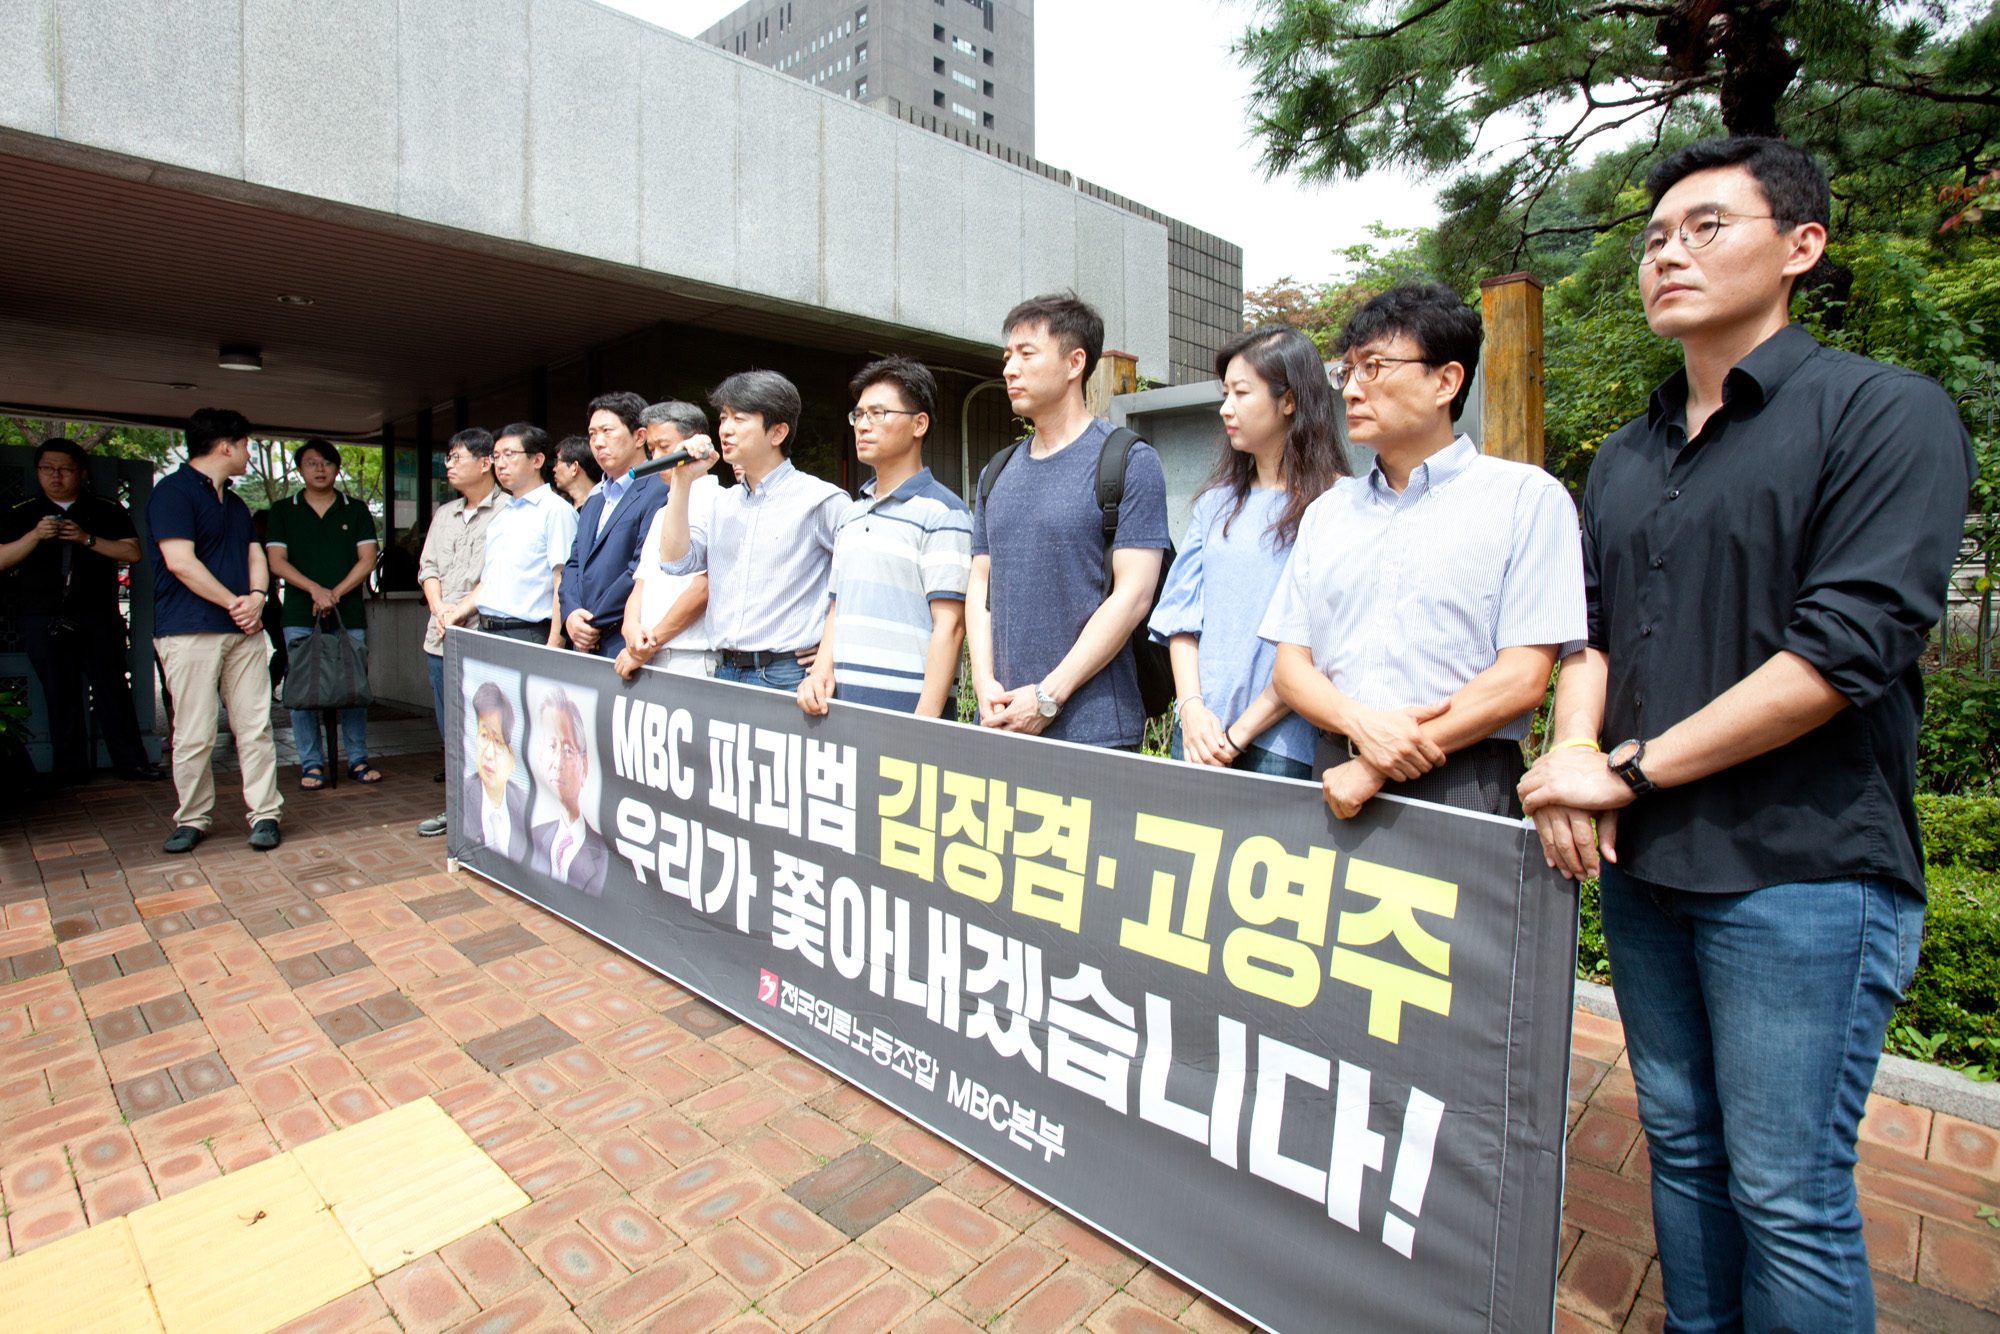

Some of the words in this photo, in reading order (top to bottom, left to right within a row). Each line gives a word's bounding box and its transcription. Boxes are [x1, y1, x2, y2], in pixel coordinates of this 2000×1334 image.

[612, 696, 694, 800] MBC
[709, 720, 857, 854] 파괴범
[616, 797, 757, 933] 우리가
[771, 850, 1445, 1259] 쫓아내겠습니다!
[780, 979, 939, 1092] 전국언론노동조합
[947, 1070, 1066, 1162] MBC본부
